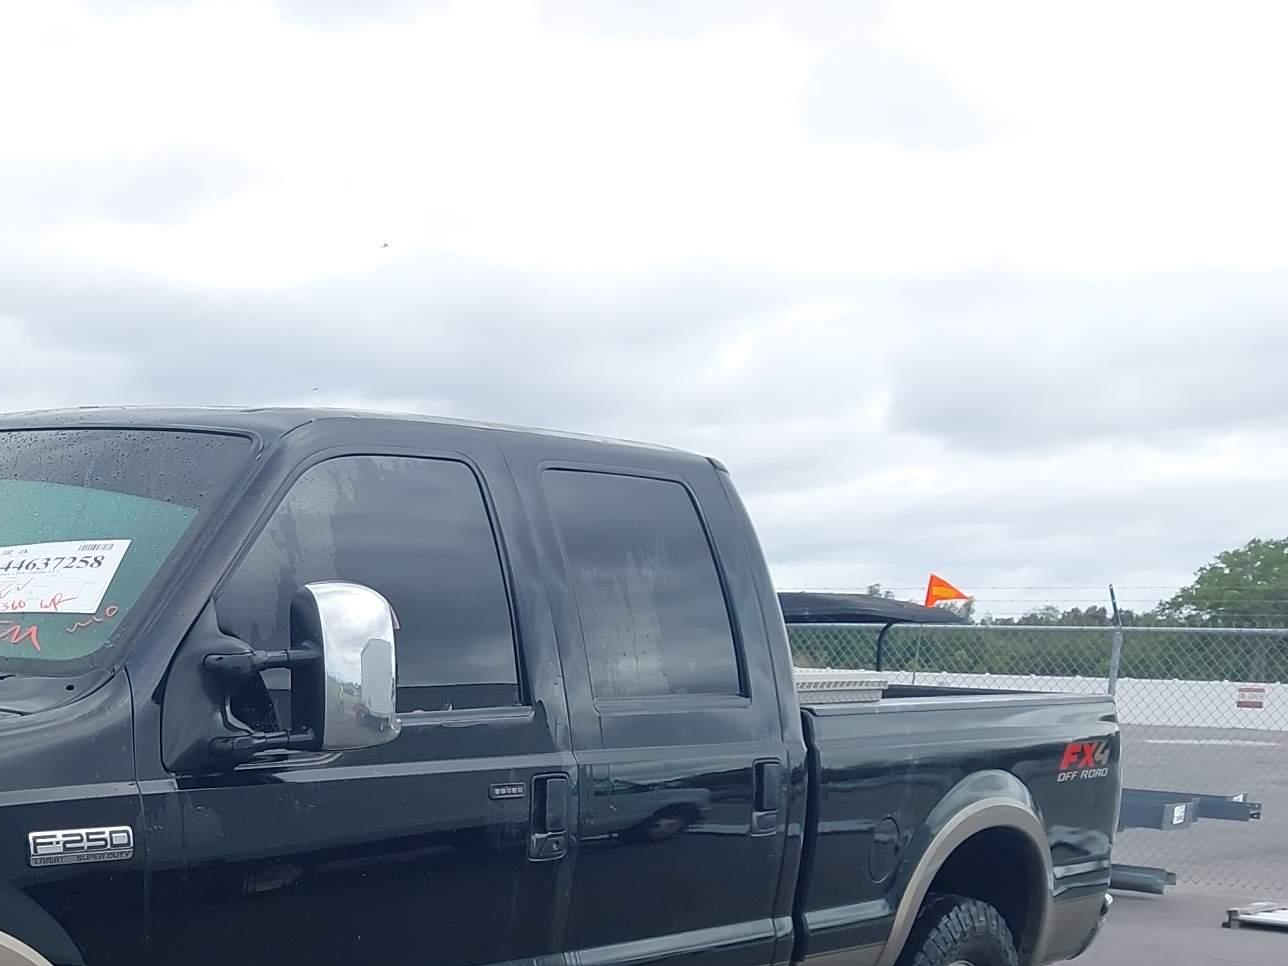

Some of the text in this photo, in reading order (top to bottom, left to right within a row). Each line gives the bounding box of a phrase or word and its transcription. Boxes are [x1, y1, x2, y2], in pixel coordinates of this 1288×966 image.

[0, 555, 105, 572] 44637258
[1059, 742, 1111, 769] FX4
[1057, 768, 1108, 782] OFF ROAD
[32, 830, 132, 855] F-250
[34, 851, 132, 865] LARIAT SUPER DUTY
